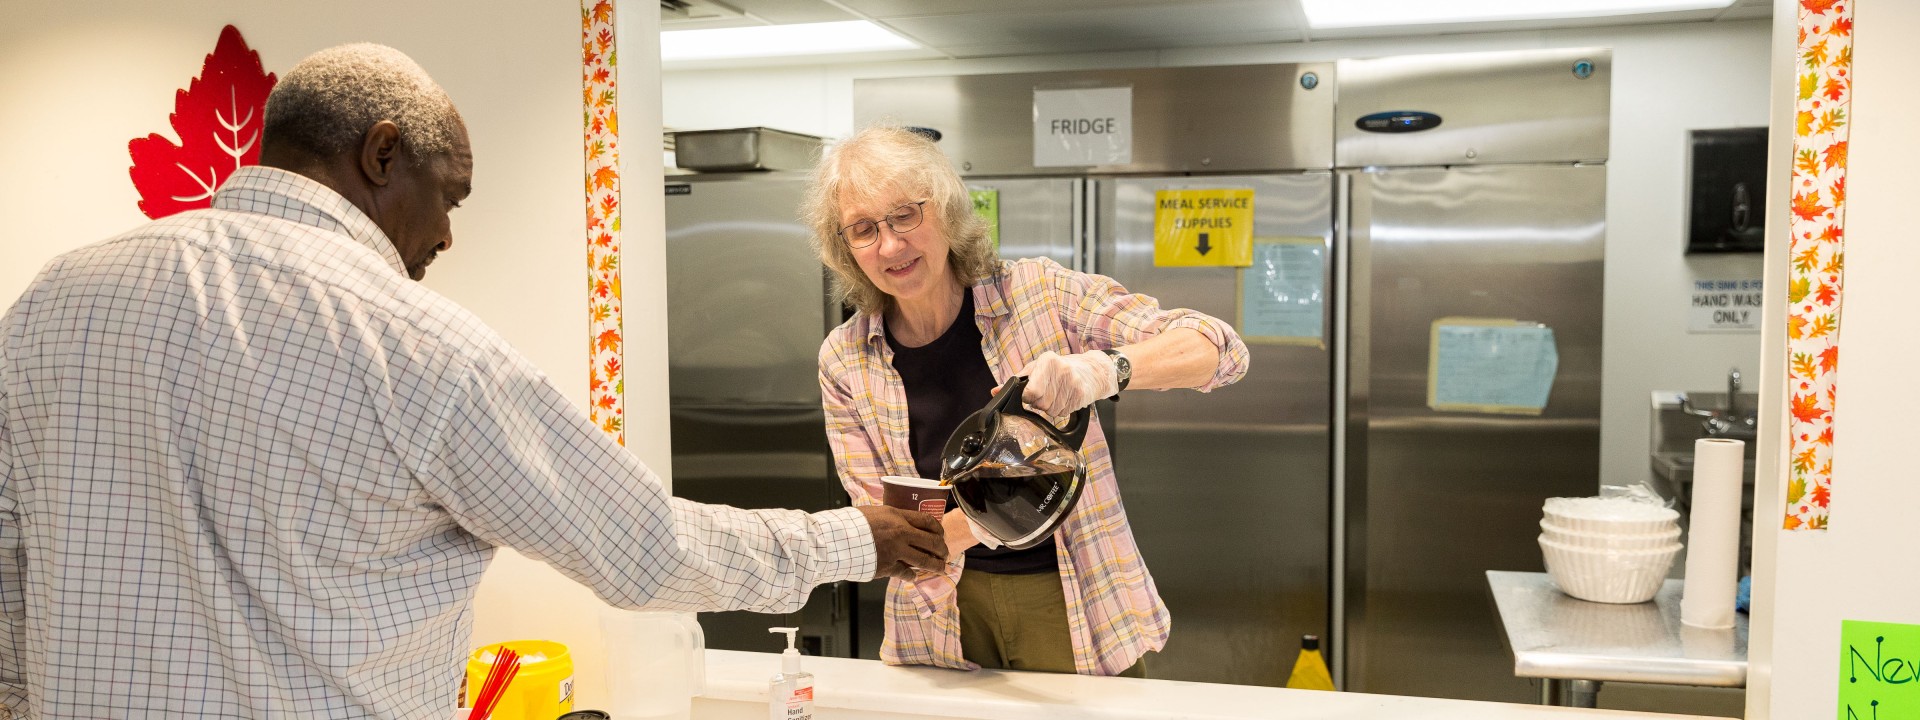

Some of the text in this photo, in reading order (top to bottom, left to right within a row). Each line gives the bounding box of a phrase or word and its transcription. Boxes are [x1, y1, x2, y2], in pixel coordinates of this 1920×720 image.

[1051, 117, 1116, 135] FRIDGE
[1160, 197, 1249, 209] MEAL SERVICE
[1175, 217, 1233, 230] SUPPLIES
[1694, 280, 1715, 291] THIS
[1692, 294, 1763, 307] HAND WAS
[1713, 310, 1751, 323] ONLY
[1044, 484, 1060, 505] COFFEE
[787, 707, 804, 716] Hand
